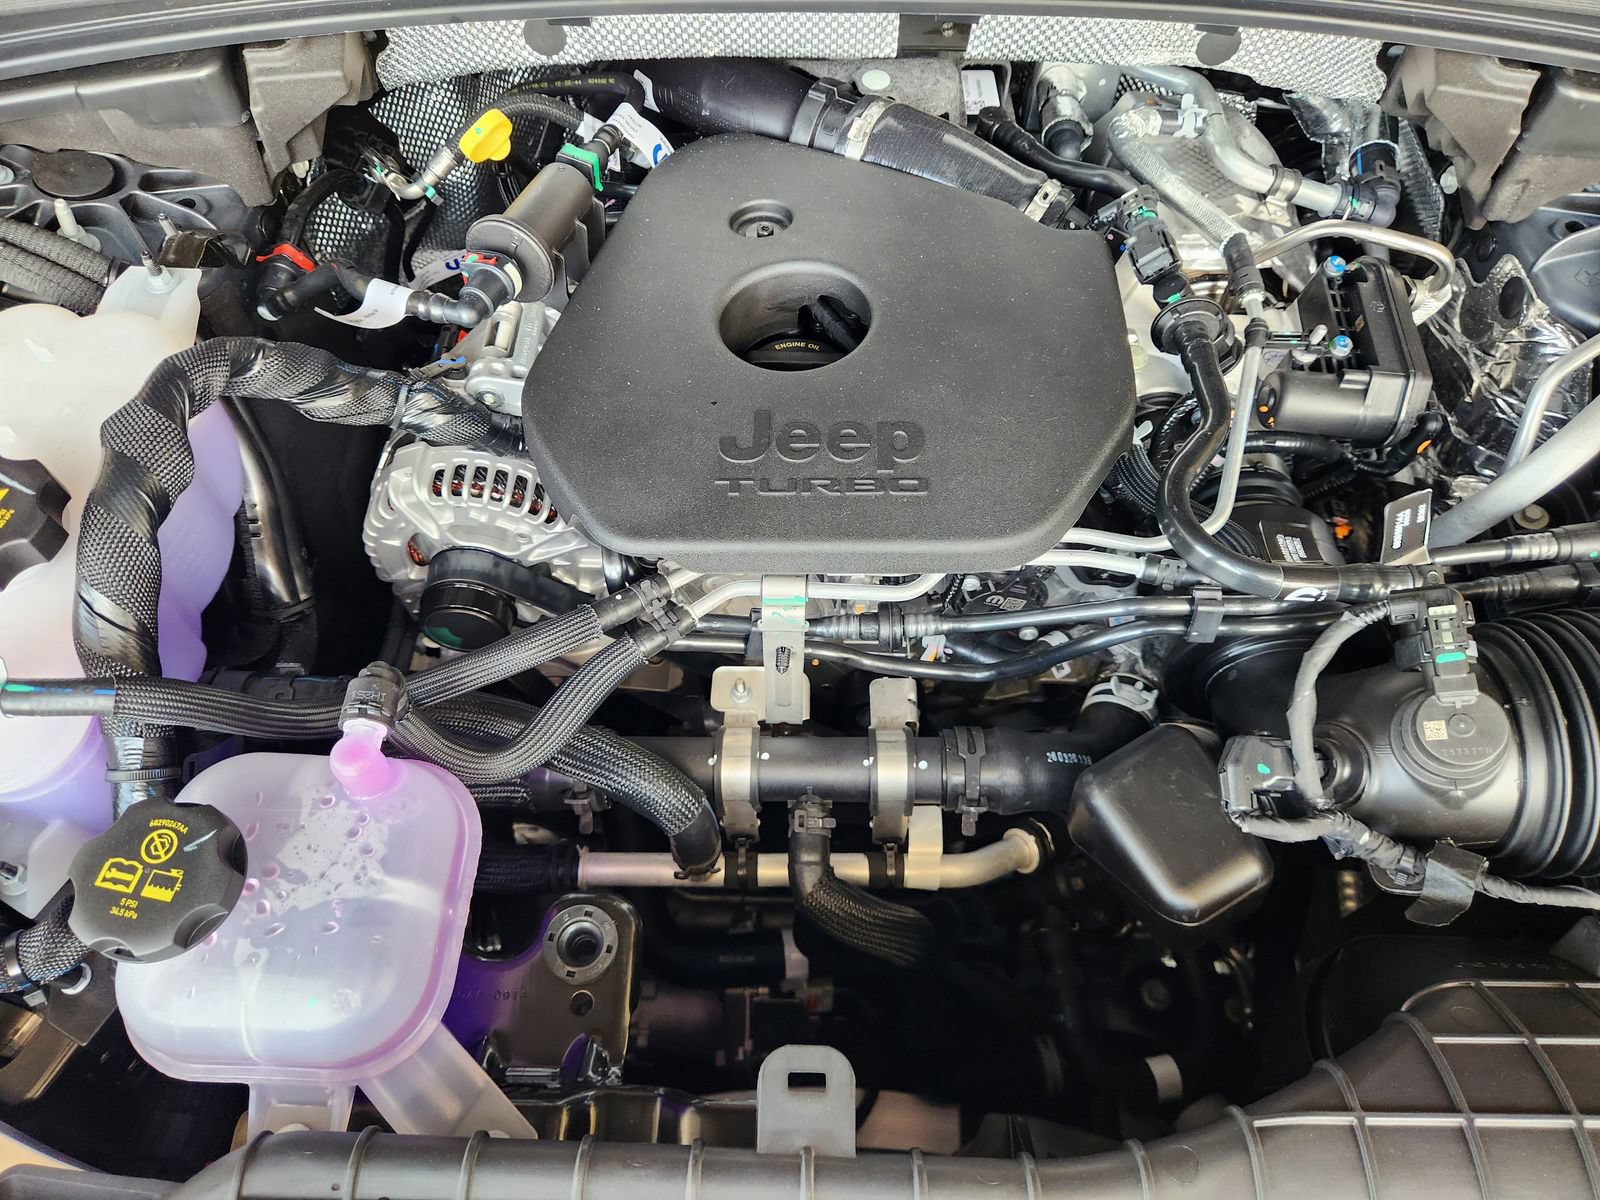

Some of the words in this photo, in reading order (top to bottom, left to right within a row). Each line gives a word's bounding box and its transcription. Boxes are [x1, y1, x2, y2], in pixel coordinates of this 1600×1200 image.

[774, 341, 806, 351] ENGINE
[808, 343, 821, 352] OIL
[719, 409, 925, 474] Jeep
[714, 477, 930, 496] TURBO
[149, 819, 188, 834] 68290267AA
[120, 897, 127, 906] 5
[125, 899, 139, 909] PSI
[124, 909, 138, 920] kPa
